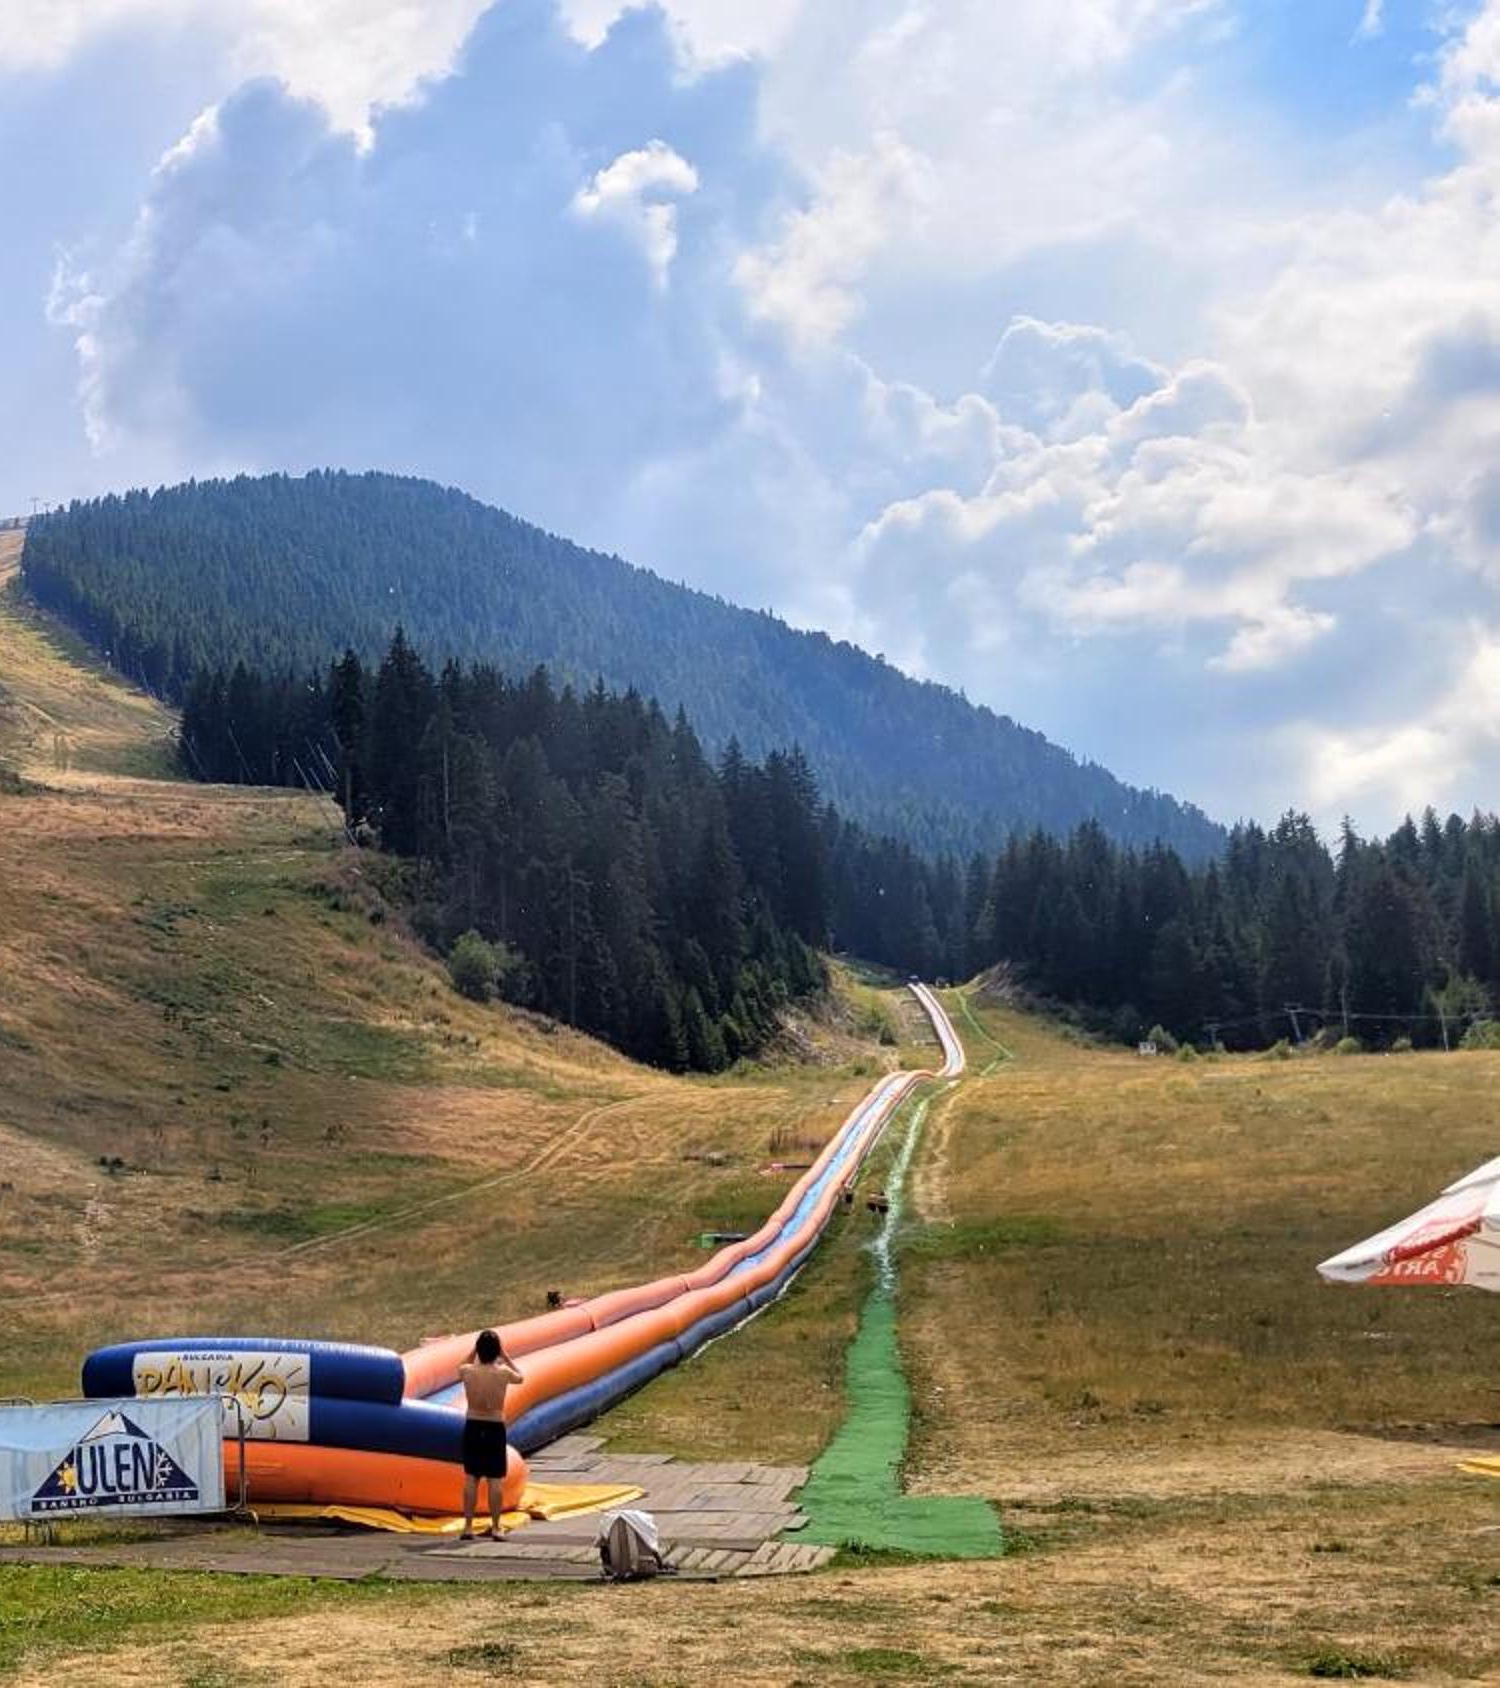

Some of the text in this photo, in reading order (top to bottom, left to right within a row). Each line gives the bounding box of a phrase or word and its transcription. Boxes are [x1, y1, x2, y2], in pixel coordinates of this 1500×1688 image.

[76, 1442, 156, 1495] ULEN
[40, 1492, 191, 1510] BANSKO BULGARIA
